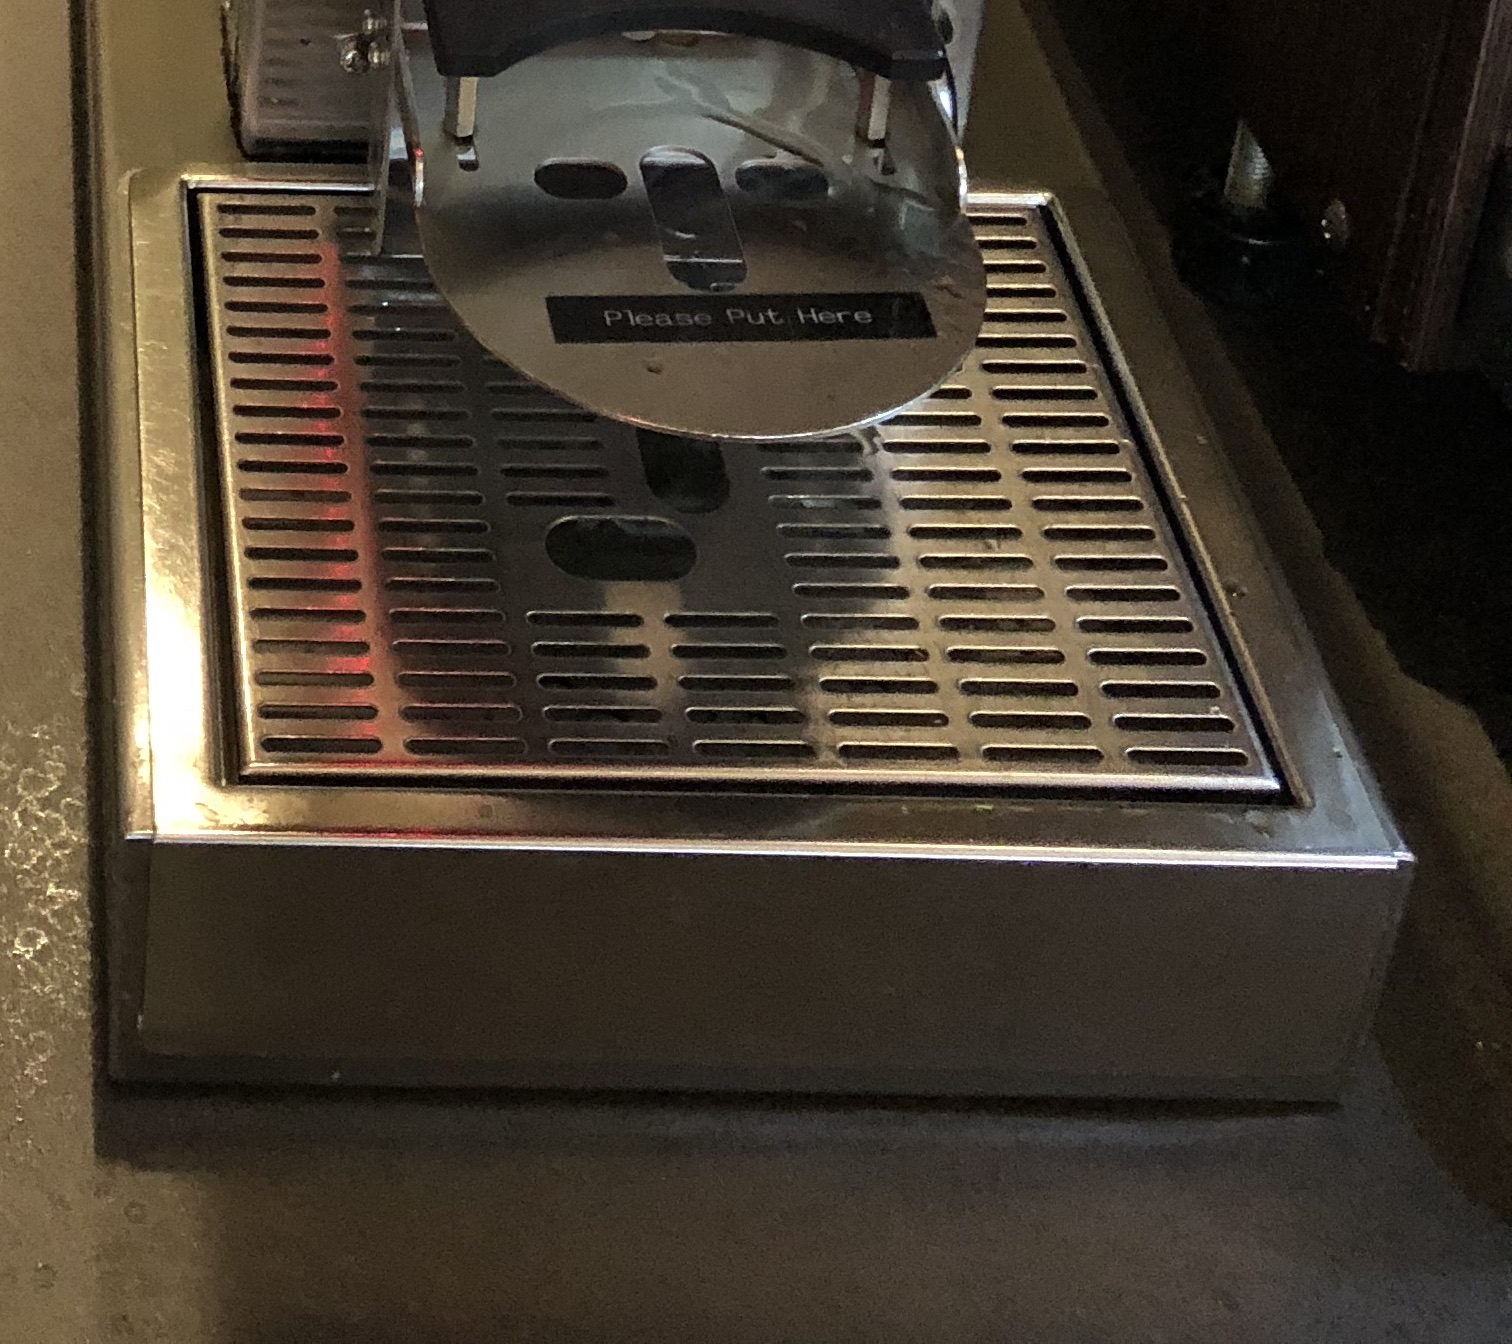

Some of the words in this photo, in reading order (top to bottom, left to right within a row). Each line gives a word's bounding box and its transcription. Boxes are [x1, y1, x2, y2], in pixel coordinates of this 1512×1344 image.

[603, 308, 712, 328] Please
[726, 307, 784, 327] Put
[796, 306, 873, 326] Here
